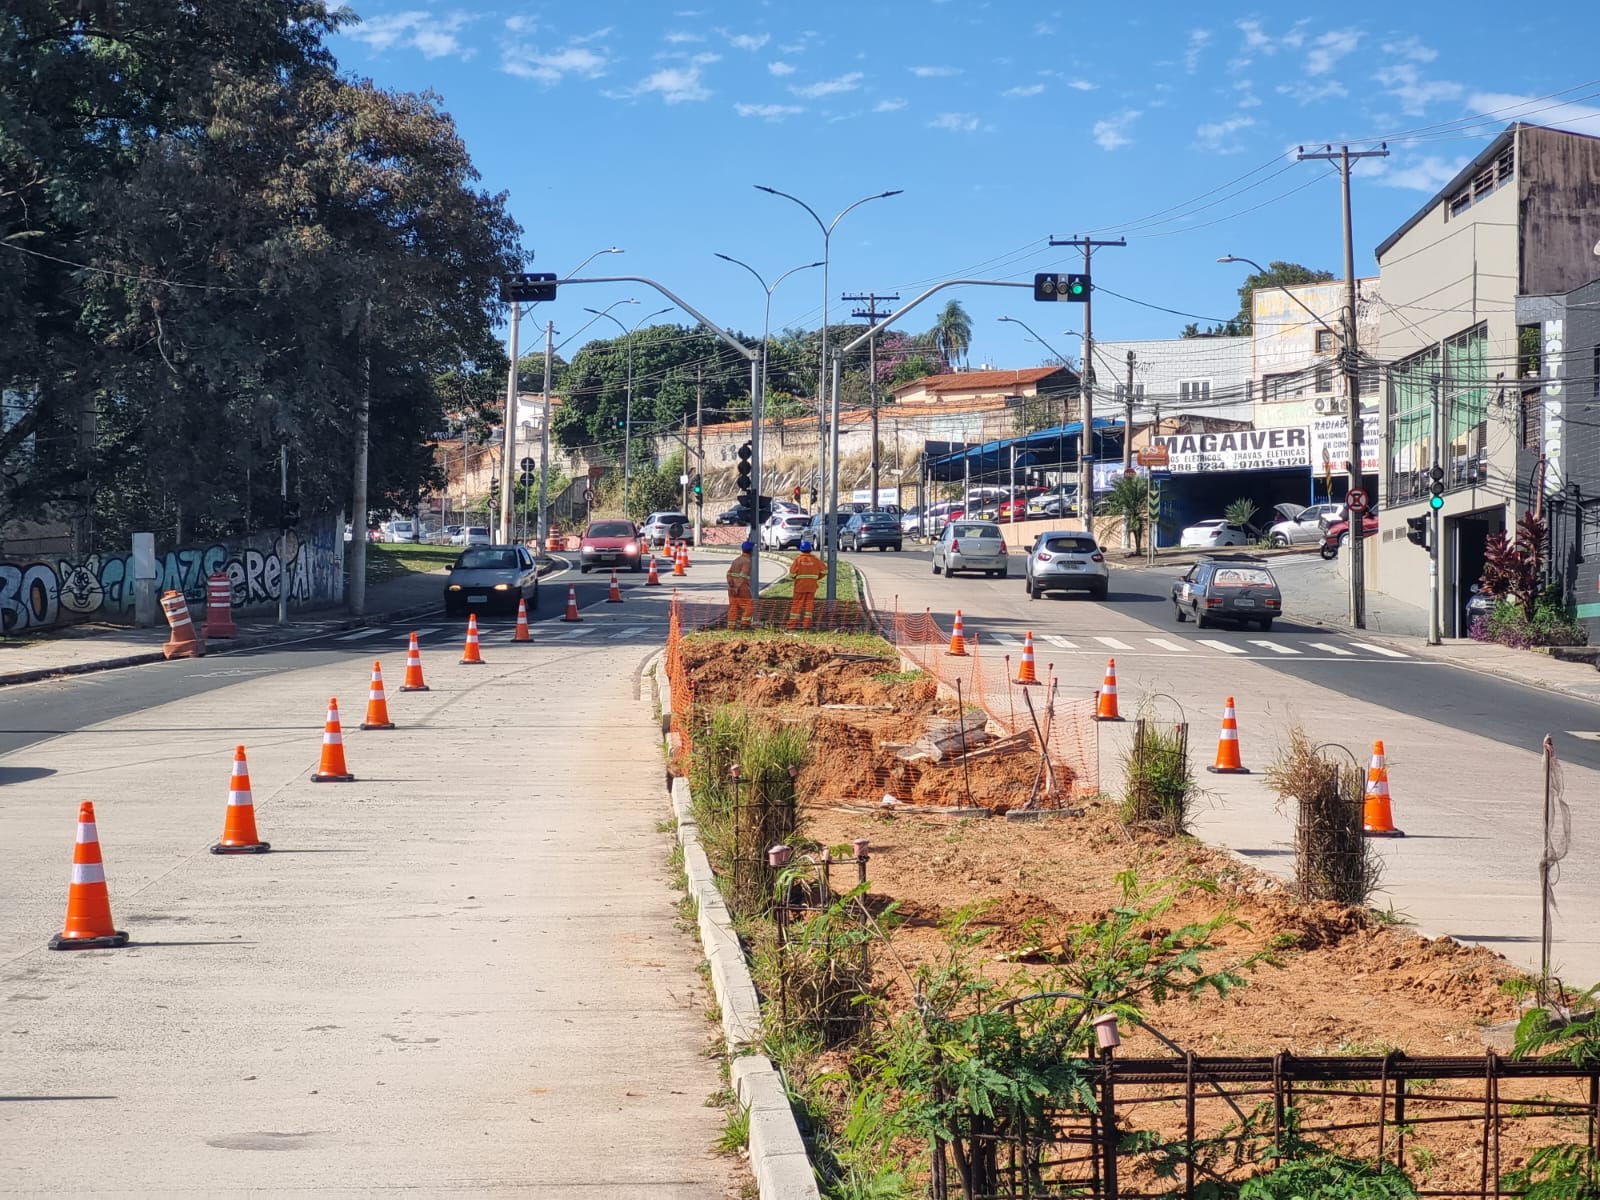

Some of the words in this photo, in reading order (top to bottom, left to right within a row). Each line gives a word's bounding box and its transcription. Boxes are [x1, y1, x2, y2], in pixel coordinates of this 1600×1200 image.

[1545, 319, 1563, 396] MOTO
[1154, 428, 1306, 454] MAGAIVER
[1234, 451, 1262, 461] TRAVAS
